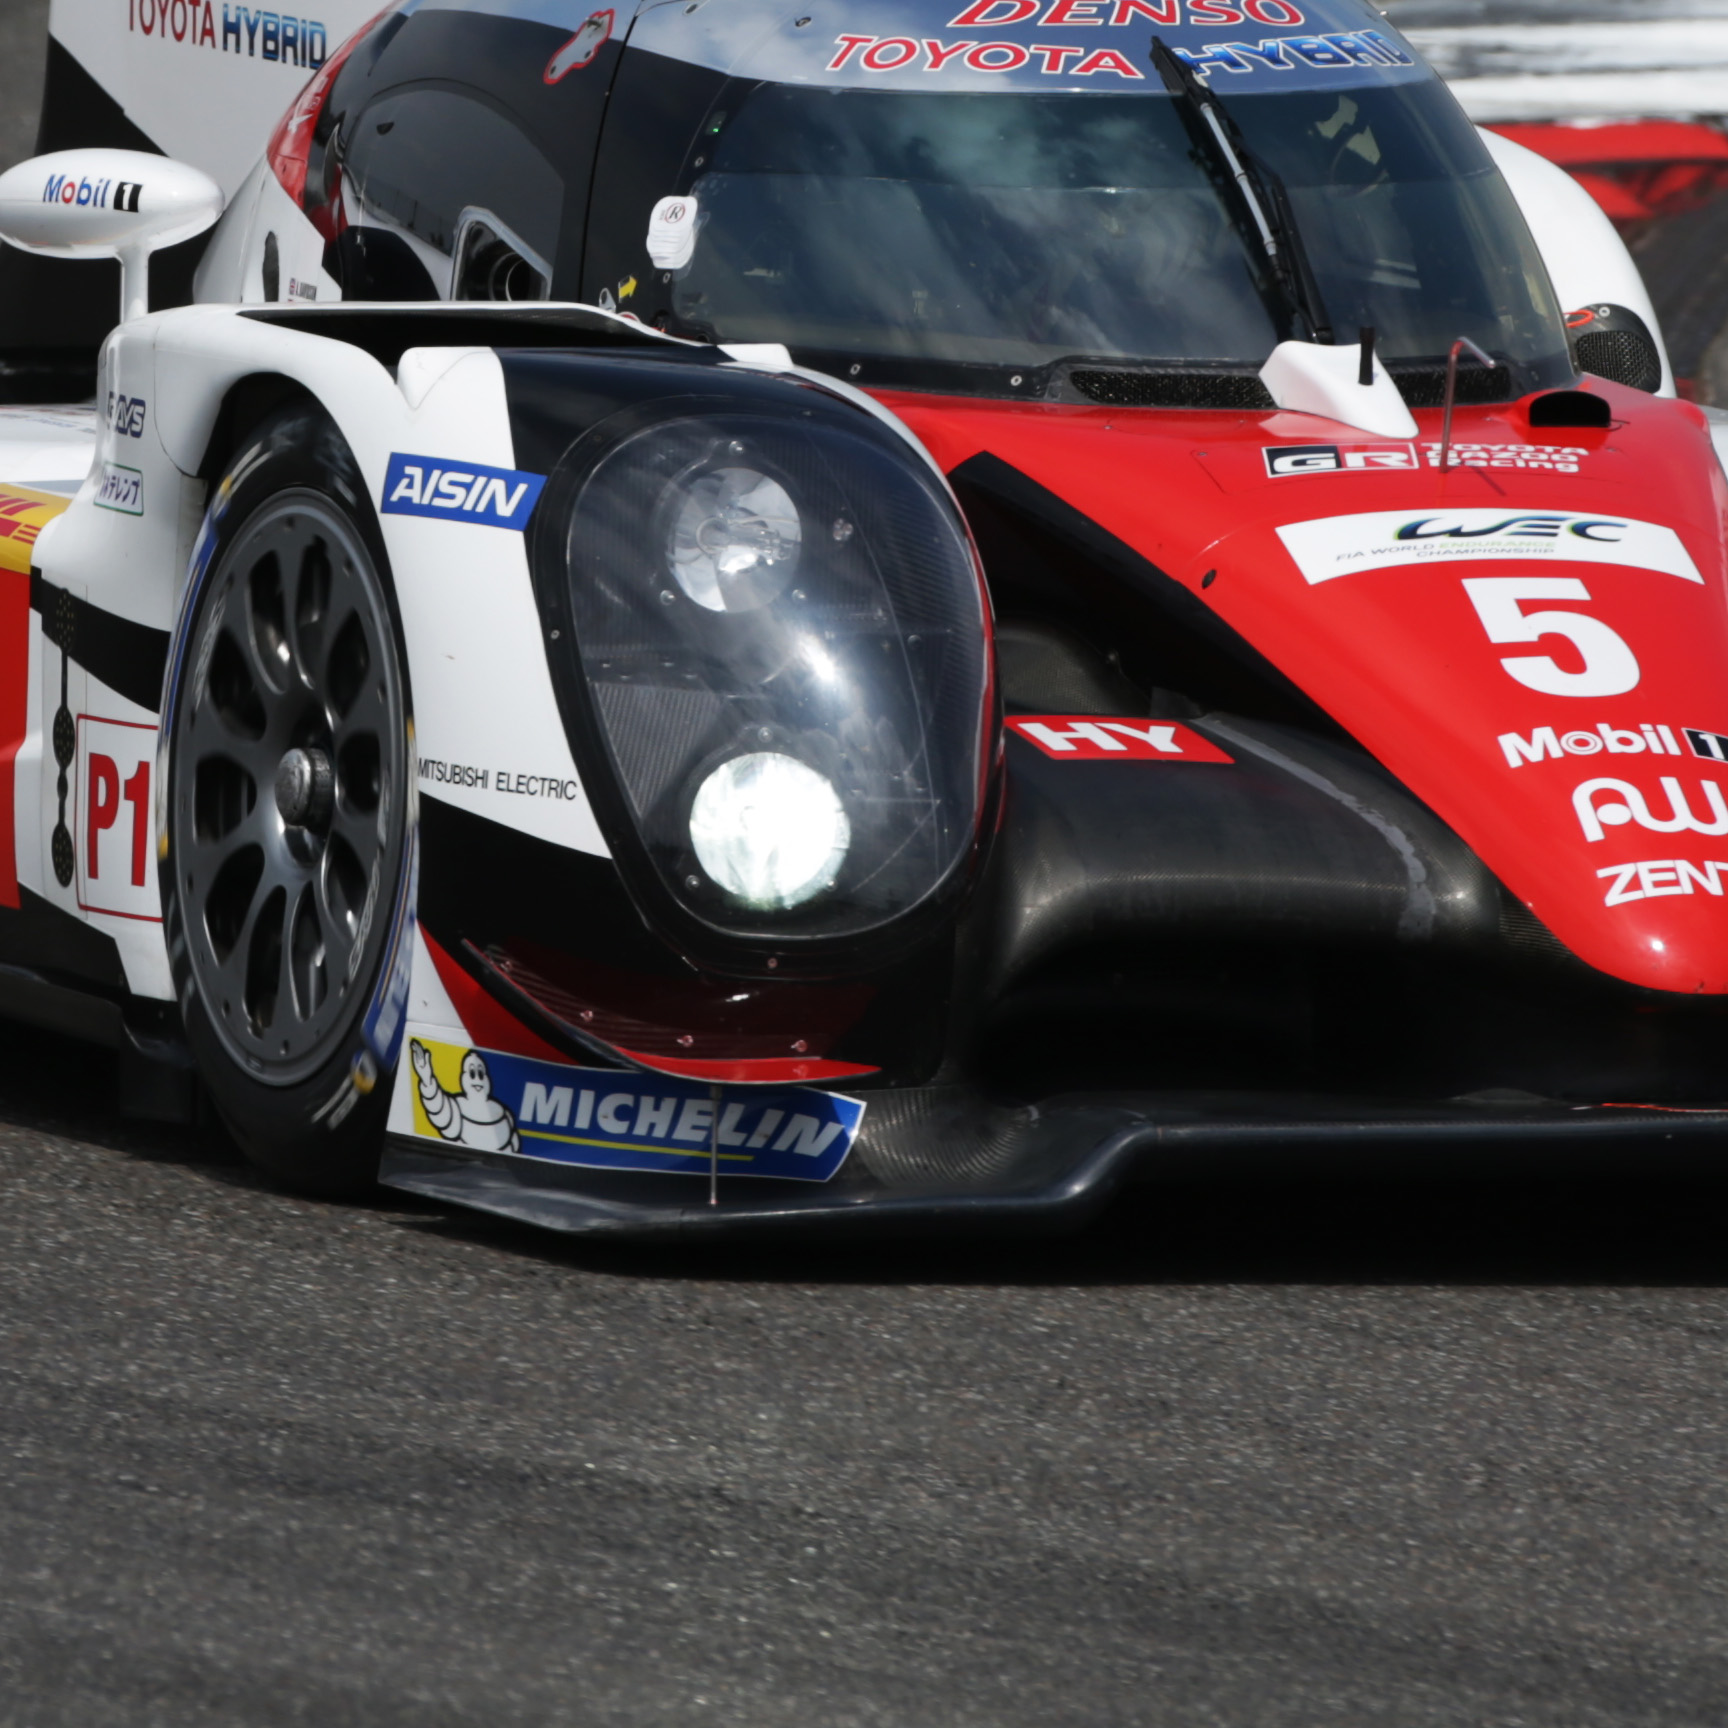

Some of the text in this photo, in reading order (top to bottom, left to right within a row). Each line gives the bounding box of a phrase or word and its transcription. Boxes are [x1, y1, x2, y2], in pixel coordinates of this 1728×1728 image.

[222, 3, 327, 70] HYBRID
[825, 29, 1415, 80] TOYOTA HYBRID
[42, 174, 143, 213] Mobil 1
[1272, 450, 1410, 472] GR
[1421, 442, 1589, 456] TOYOTA
[390, 465, 528, 518] AISIN
[1393, 516, 1628, 542] WEC
[1461, 577, 1640, 697] 5
[1017, 722, 1184, 753] HY
[1497, 723, 1682, 768] Mobil
[418, 757, 577, 801] MITSUBISHI ELECTRIC
[87, 752, 150, 887] P1
[518, 1081, 846, 1158] MICHELIN
